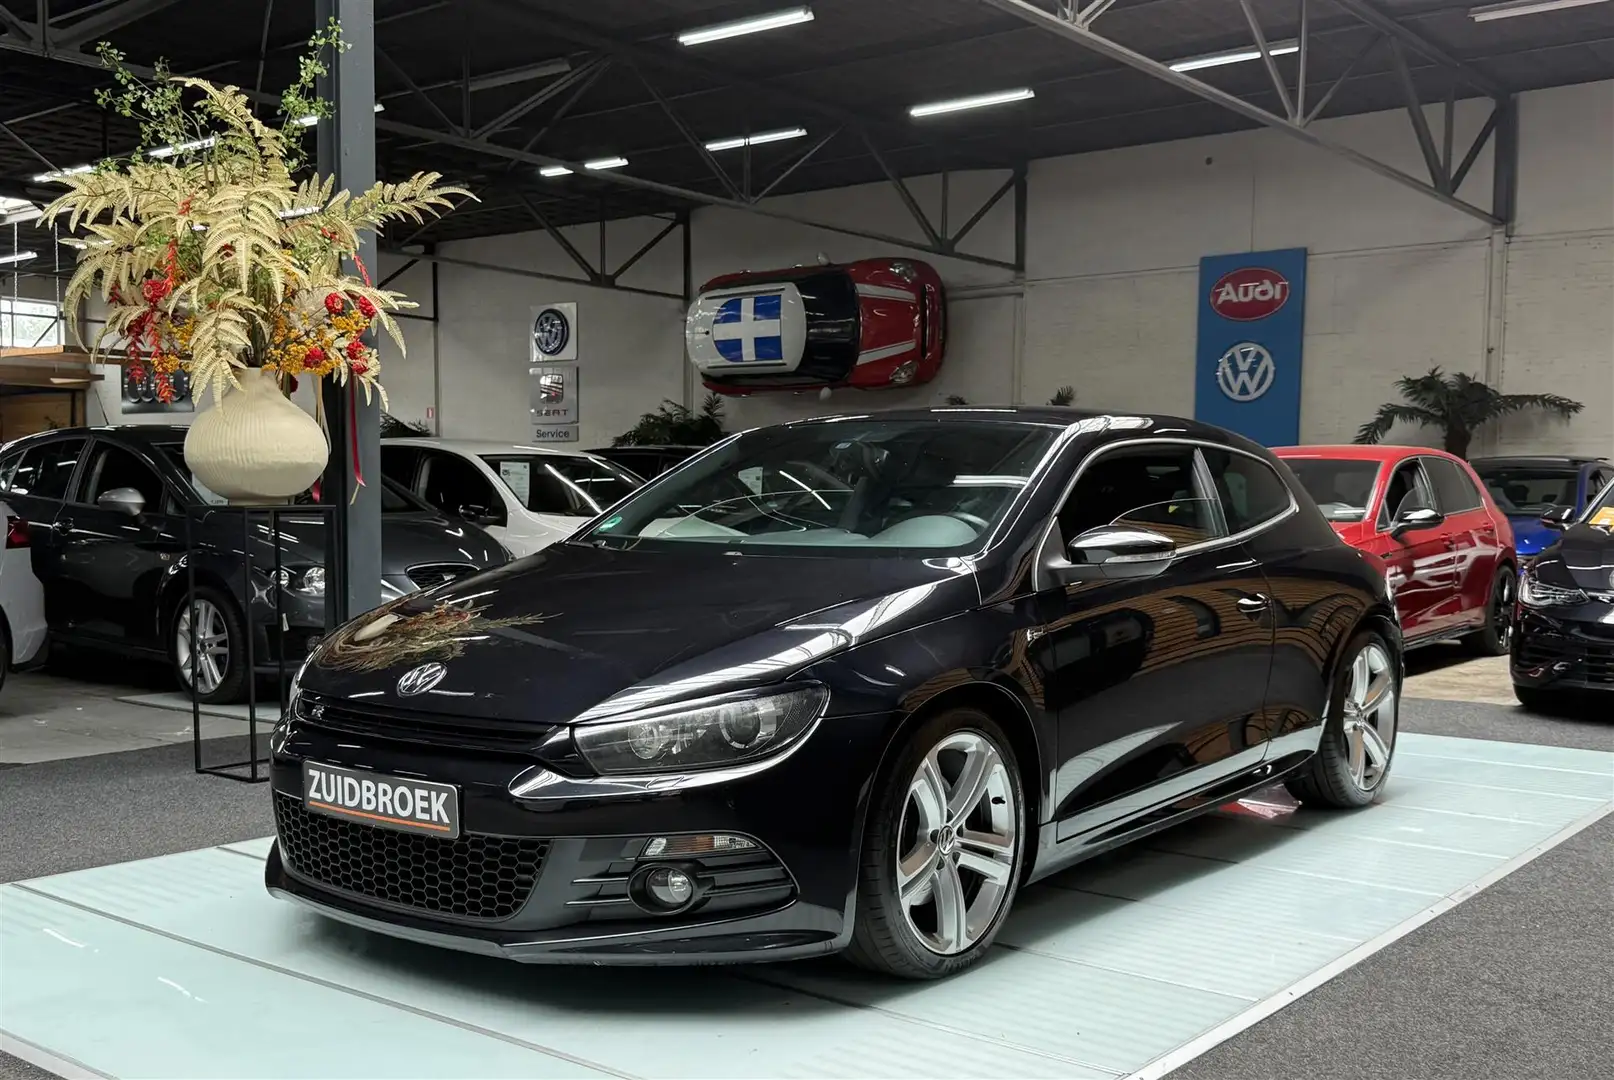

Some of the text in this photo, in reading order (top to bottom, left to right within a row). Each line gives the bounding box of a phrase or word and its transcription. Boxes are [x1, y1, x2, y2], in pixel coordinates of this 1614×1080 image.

[1217, 279, 1287, 305] Audi
[1218, 341, 1275, 402] VW
[536, 408, 569, 417] SEAT
[536, 428, 570, 439] Service
[308, 768, 450, 823] ZUIDBROEK
